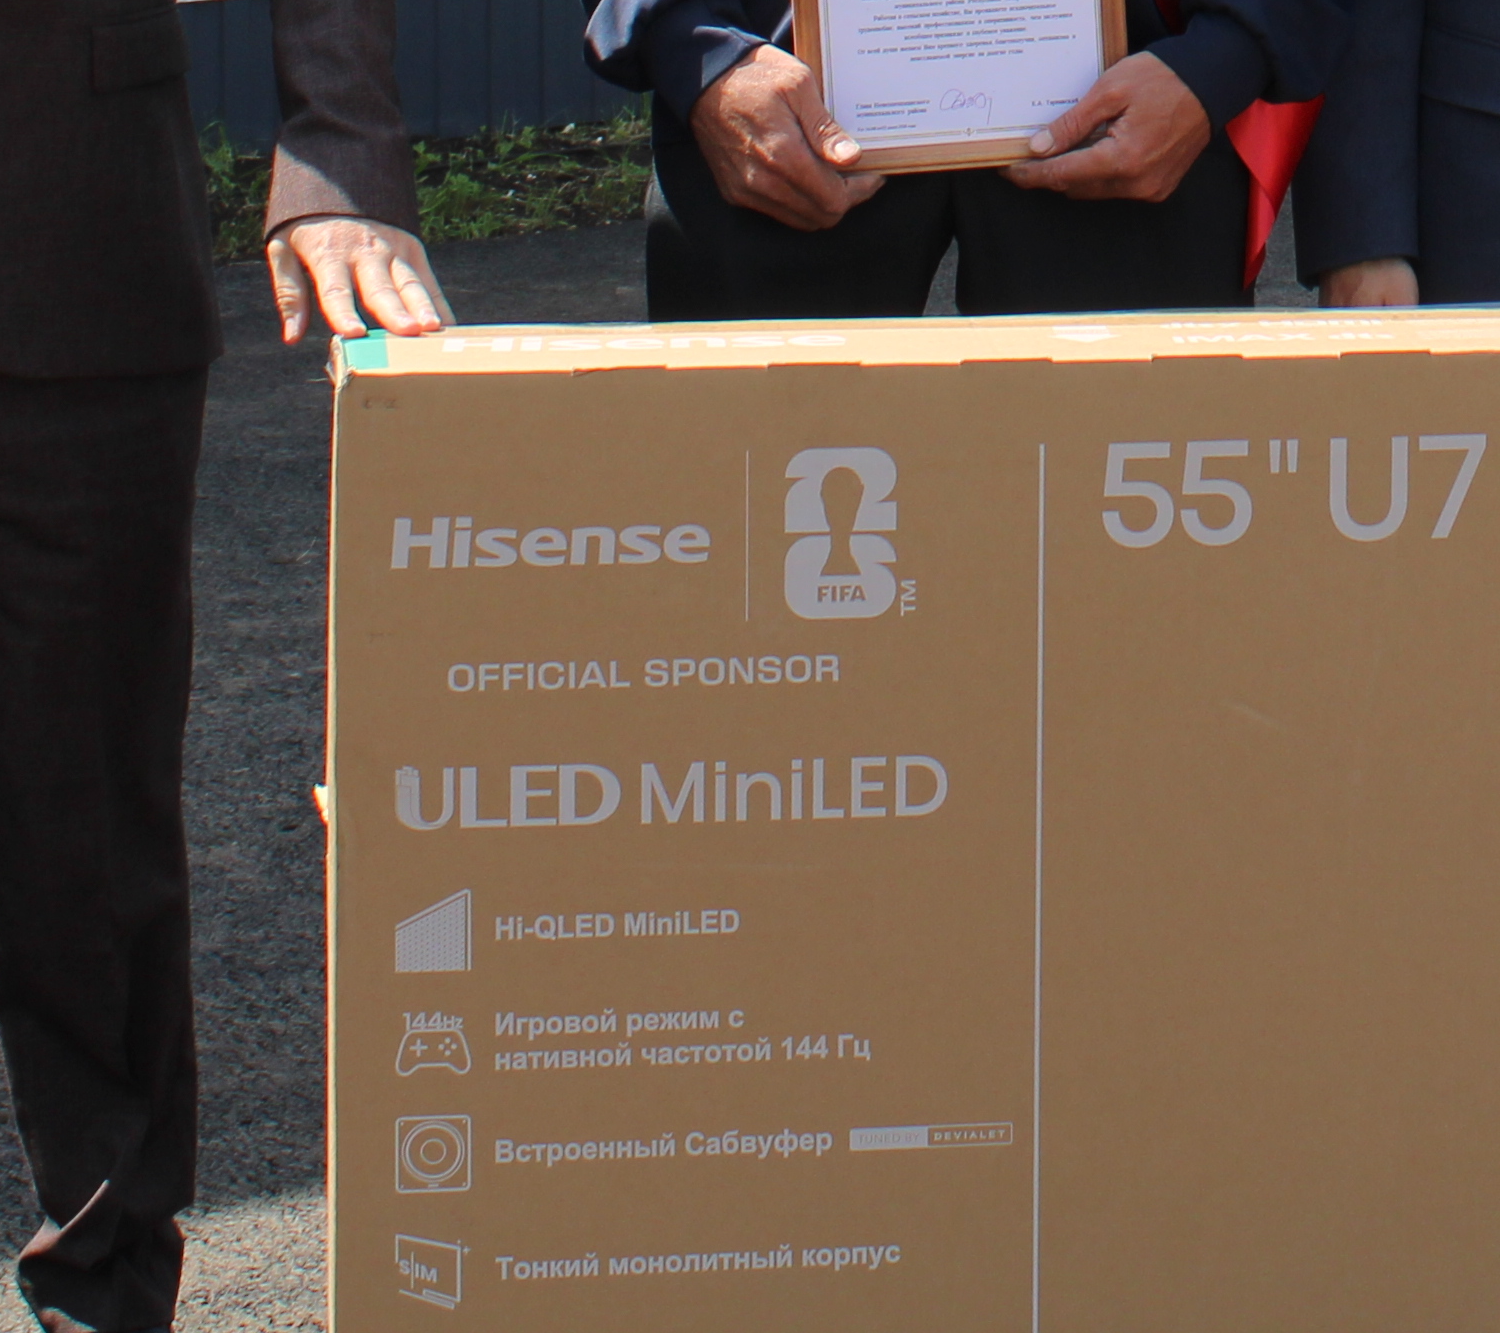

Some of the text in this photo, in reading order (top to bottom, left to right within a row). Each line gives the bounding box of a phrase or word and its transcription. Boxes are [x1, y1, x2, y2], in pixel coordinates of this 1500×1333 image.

[442, 333, 847, 353] Hisense
[1172, 332, 1316, 344] IMAX
[1101, 433, 1487, 549] 55" U7
[390, 516, 711, 570] Hisense
[816, 585, 867, 603] FIFA
[900, 579, 917, 616] TM
[447, 655, 840, 692] OFFICIAL SPONSOR
[394, 755, 949, 831] ULED MiniLED
[494, 909, 741, 942] Hi-QLED MiniLED
[402, 1011, 464, 1031] 144Hz
[494, 1008, 744, 1040] Игровой режим с
[494, 1034, 872, 1071] нативной частотой 144 Гц
[494, 1128, 834, 1169] Встроенный Сабвуфер
[858, 1129, 1006, 1145] TUNED BY DEVIALET
[494, 1244, 902, 1282] Тонкий монолитный корпус
